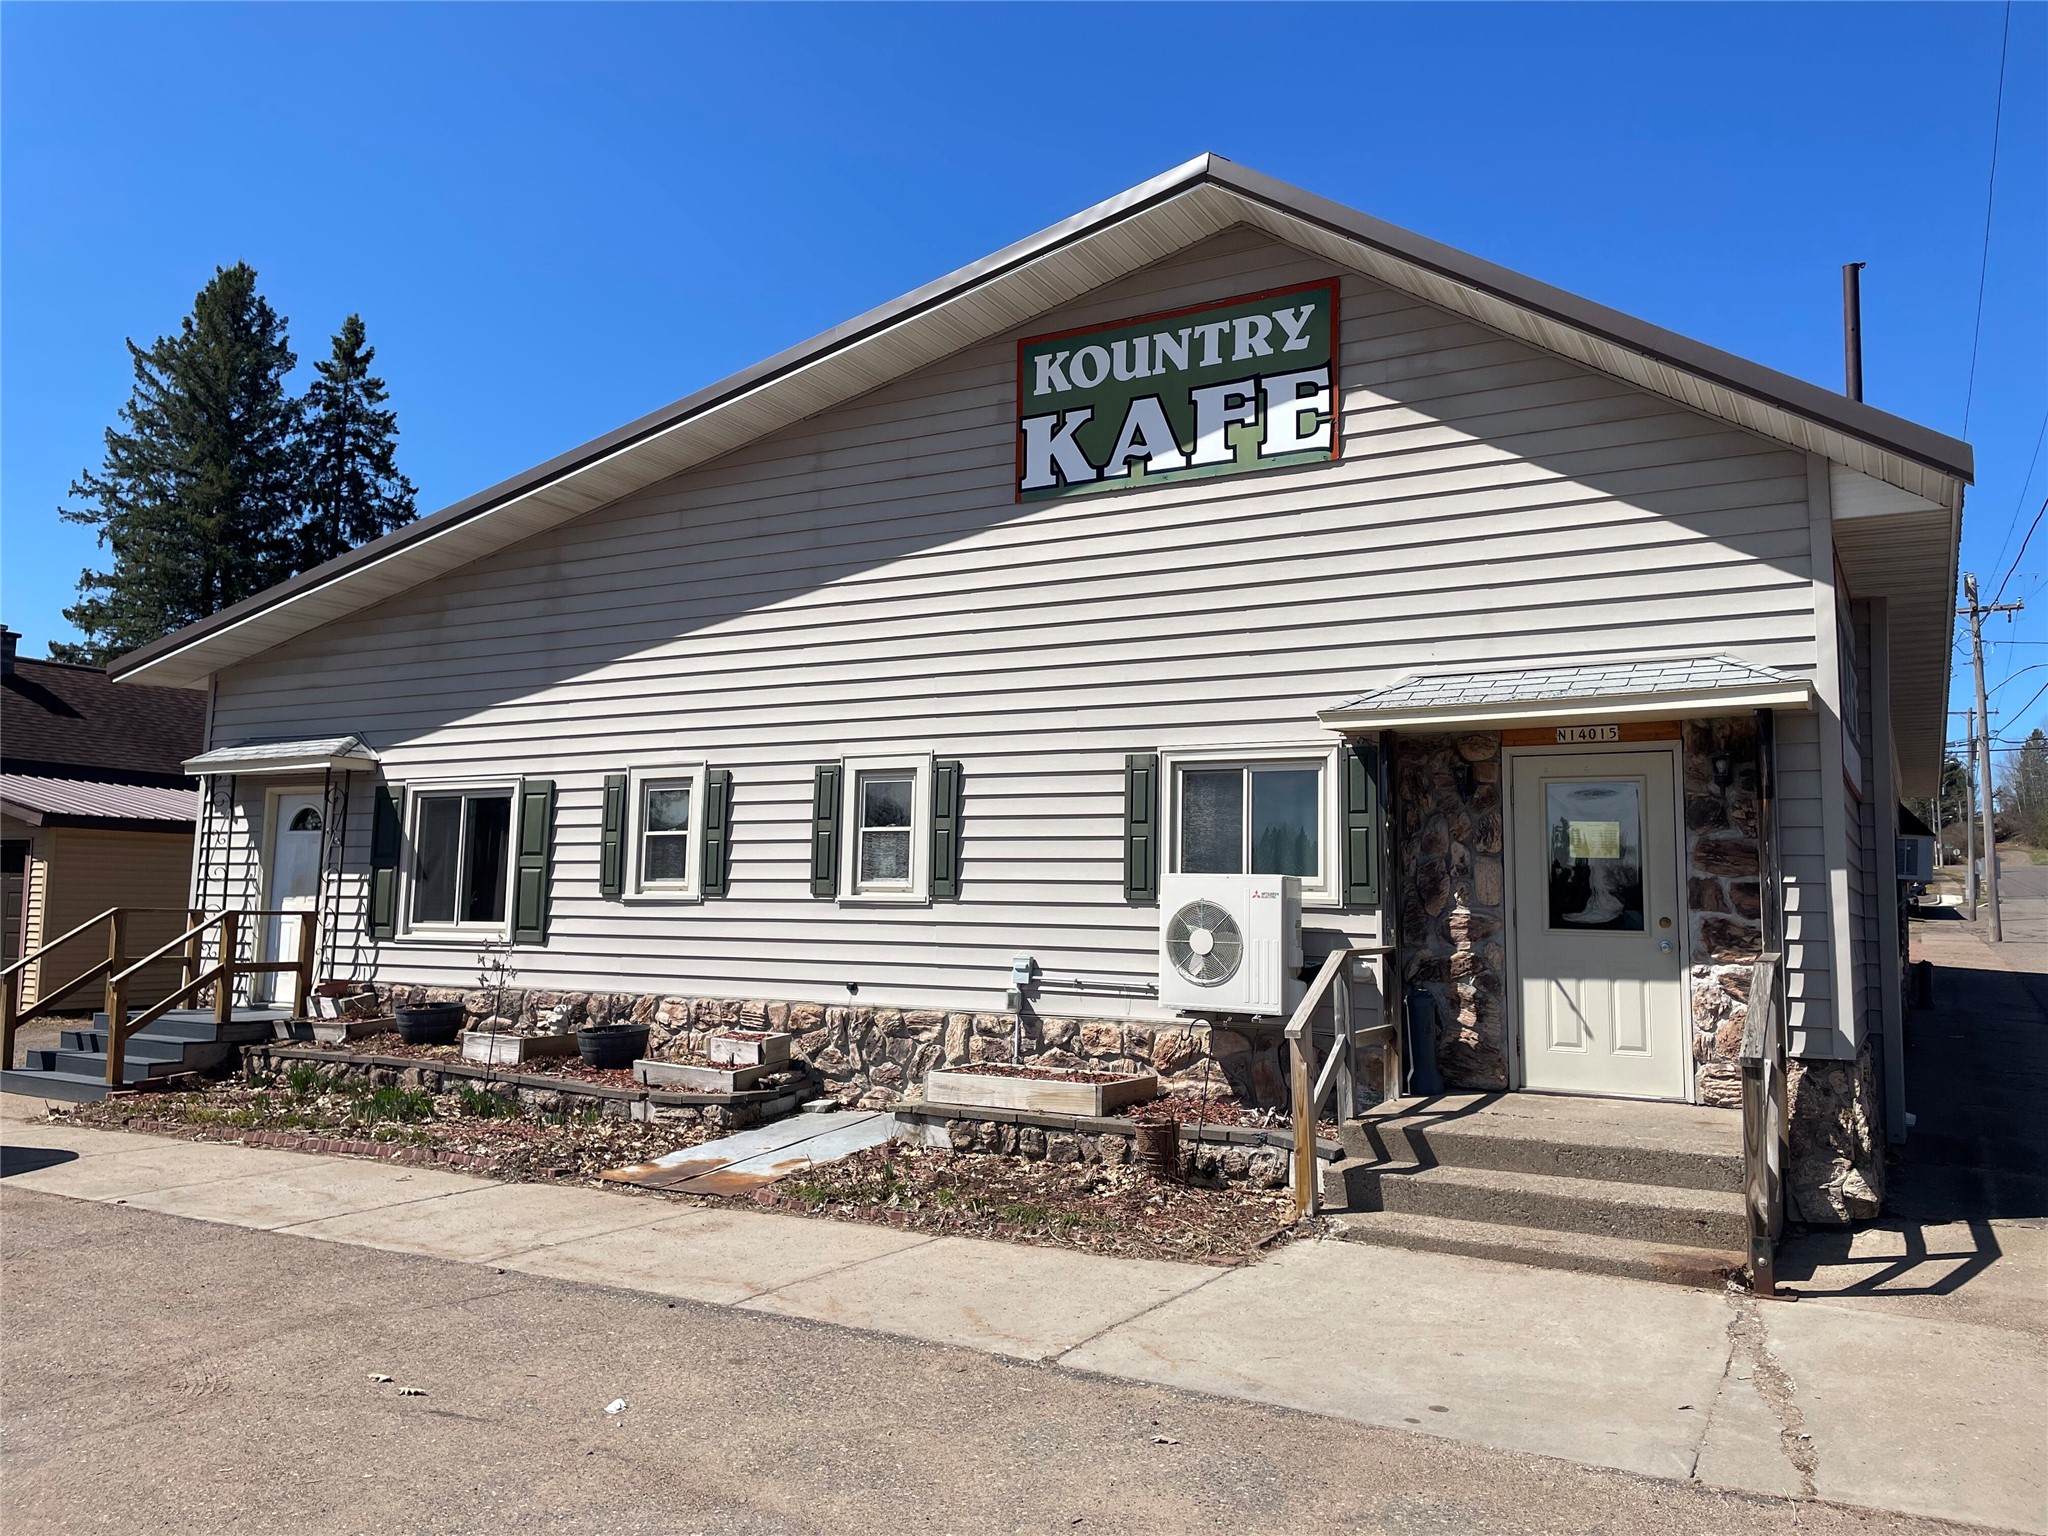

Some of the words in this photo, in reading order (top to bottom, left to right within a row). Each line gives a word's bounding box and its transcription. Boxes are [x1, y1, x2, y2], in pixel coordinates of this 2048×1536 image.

[1033, 303, 1316, 396] KOUNTRY
[1019, 363, 1333, 491] KAFE
[1558, 727, 1617, 741] N14015
